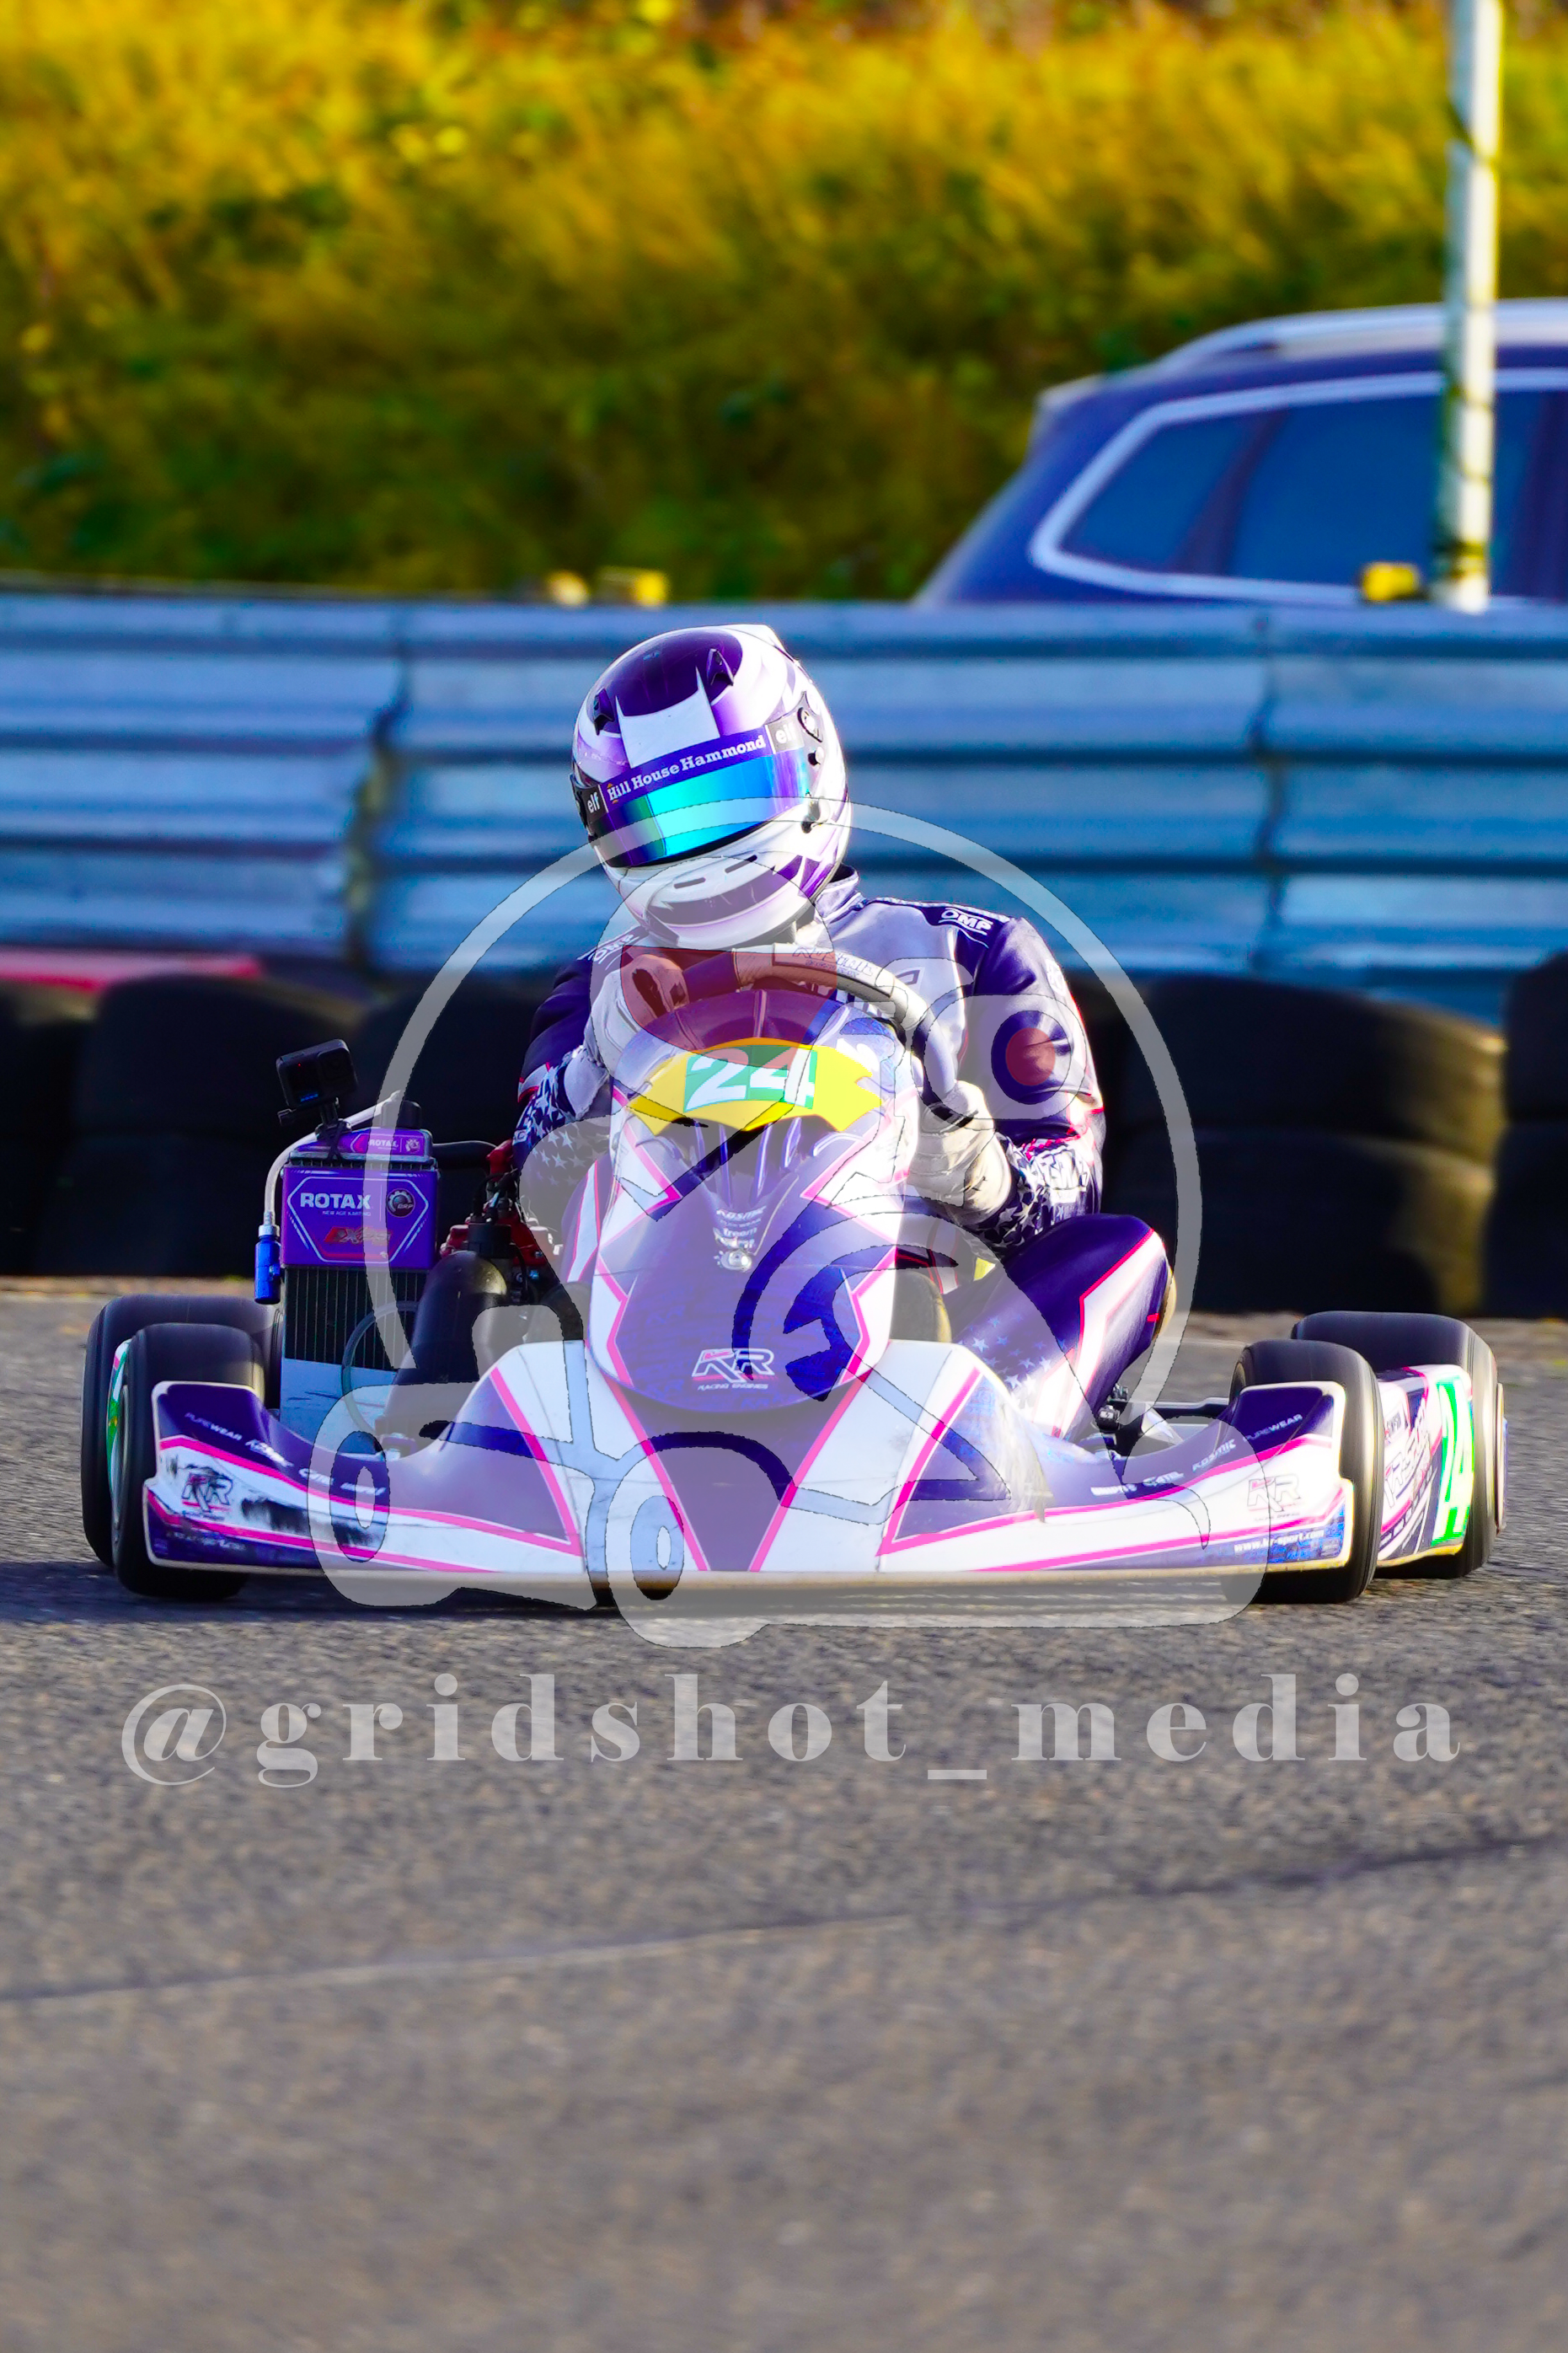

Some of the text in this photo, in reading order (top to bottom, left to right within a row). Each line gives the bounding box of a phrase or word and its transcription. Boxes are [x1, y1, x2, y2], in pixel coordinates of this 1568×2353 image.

[607, 735, 766, 801] Hill House Hammond
[586, 791, 600, 813] elf
[939, 909, 994, 935] OMP
[685, 1048, 816, 1113] 24
[299, 1192, 372, 1210] ROTAX
[691, 1347, 775, 1383] KR
[1247, 1473, 1302, 1513] KR
